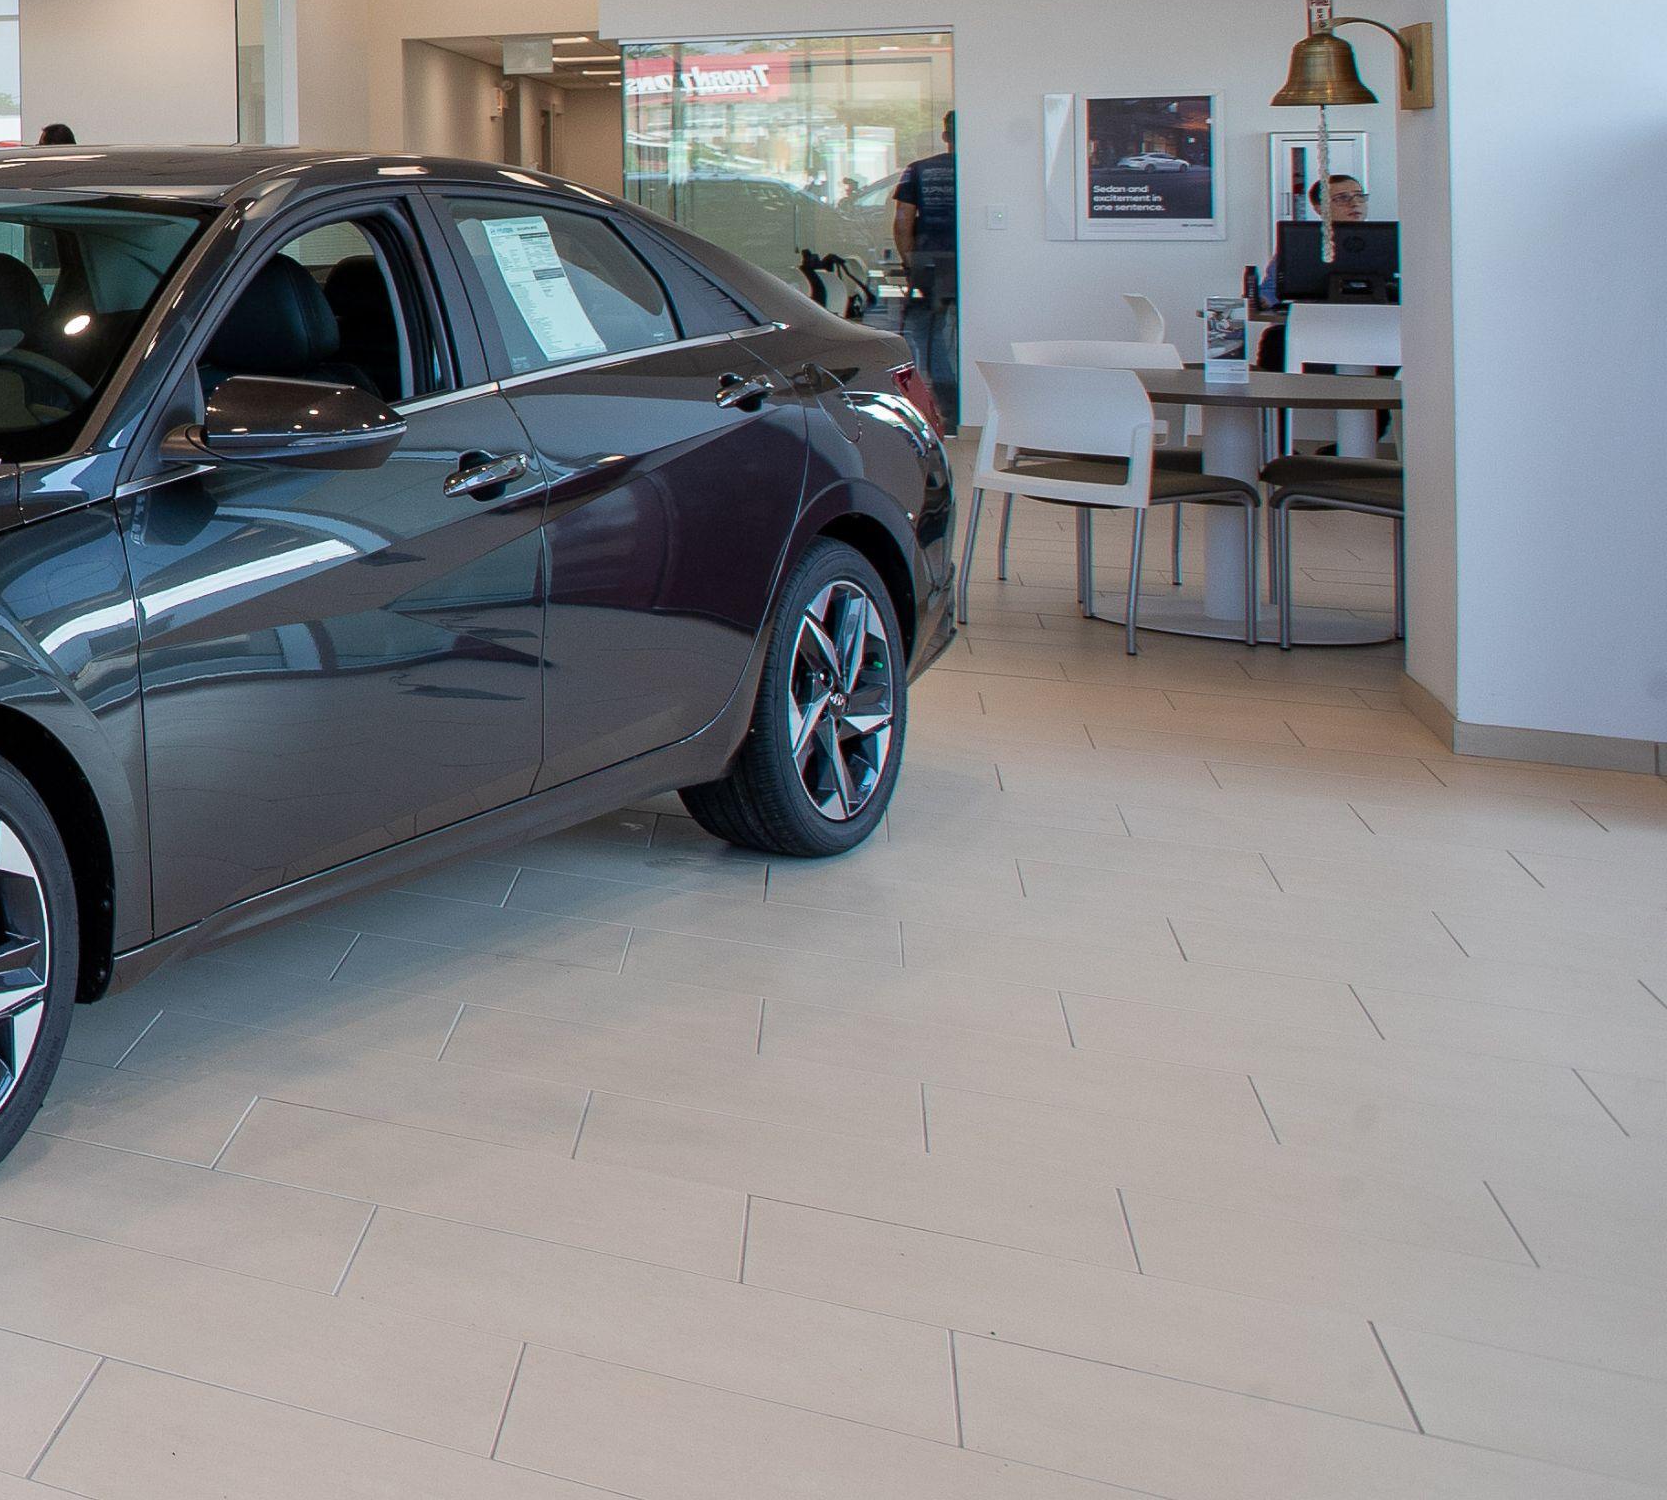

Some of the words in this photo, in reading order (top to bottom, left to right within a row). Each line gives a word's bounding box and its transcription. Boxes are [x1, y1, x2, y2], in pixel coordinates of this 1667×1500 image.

[1093, 185, 1126, 193] Sedan
[1127, 185, 1149, 193] and
[1093, 194, 1151, 202] excitement
[1152, 194, 1163, 202] in
[1114, 203, 1166, 211] sentence.
